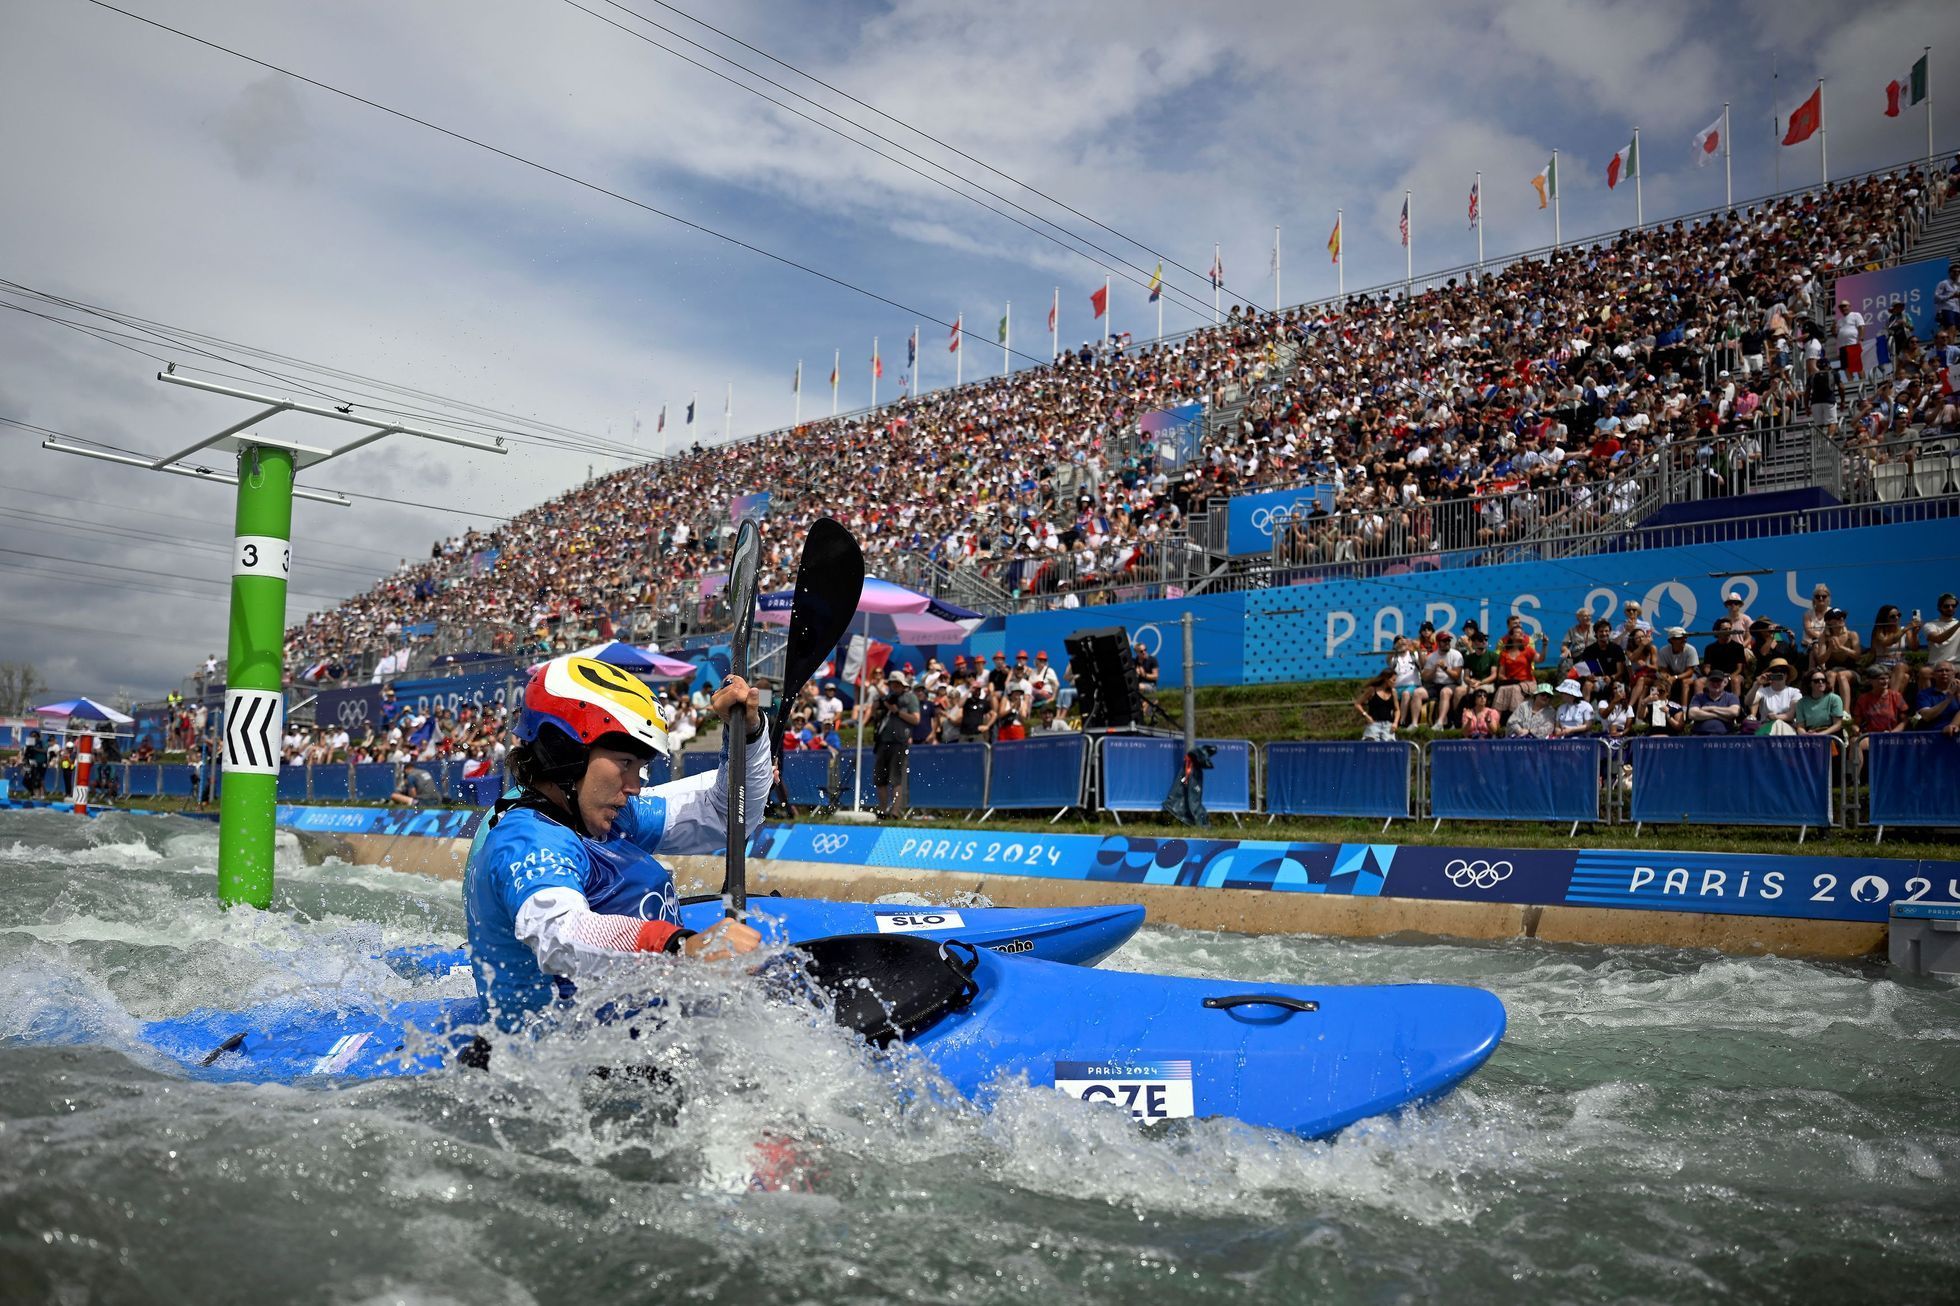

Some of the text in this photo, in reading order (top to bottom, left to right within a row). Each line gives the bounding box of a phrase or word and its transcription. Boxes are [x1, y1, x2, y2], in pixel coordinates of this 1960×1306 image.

[241, 543, 259, 568] 3
[282, 549, 290, 573] 3
[899, 838, 1061, 866] PARiS 2024
[1629, 866, 1785, 900] PARiS
[892, 915, 946, 926] SLO
[989, 939, 1034, 954] anha
[1087, 1066, 1158, 1075] PARiS 2024
